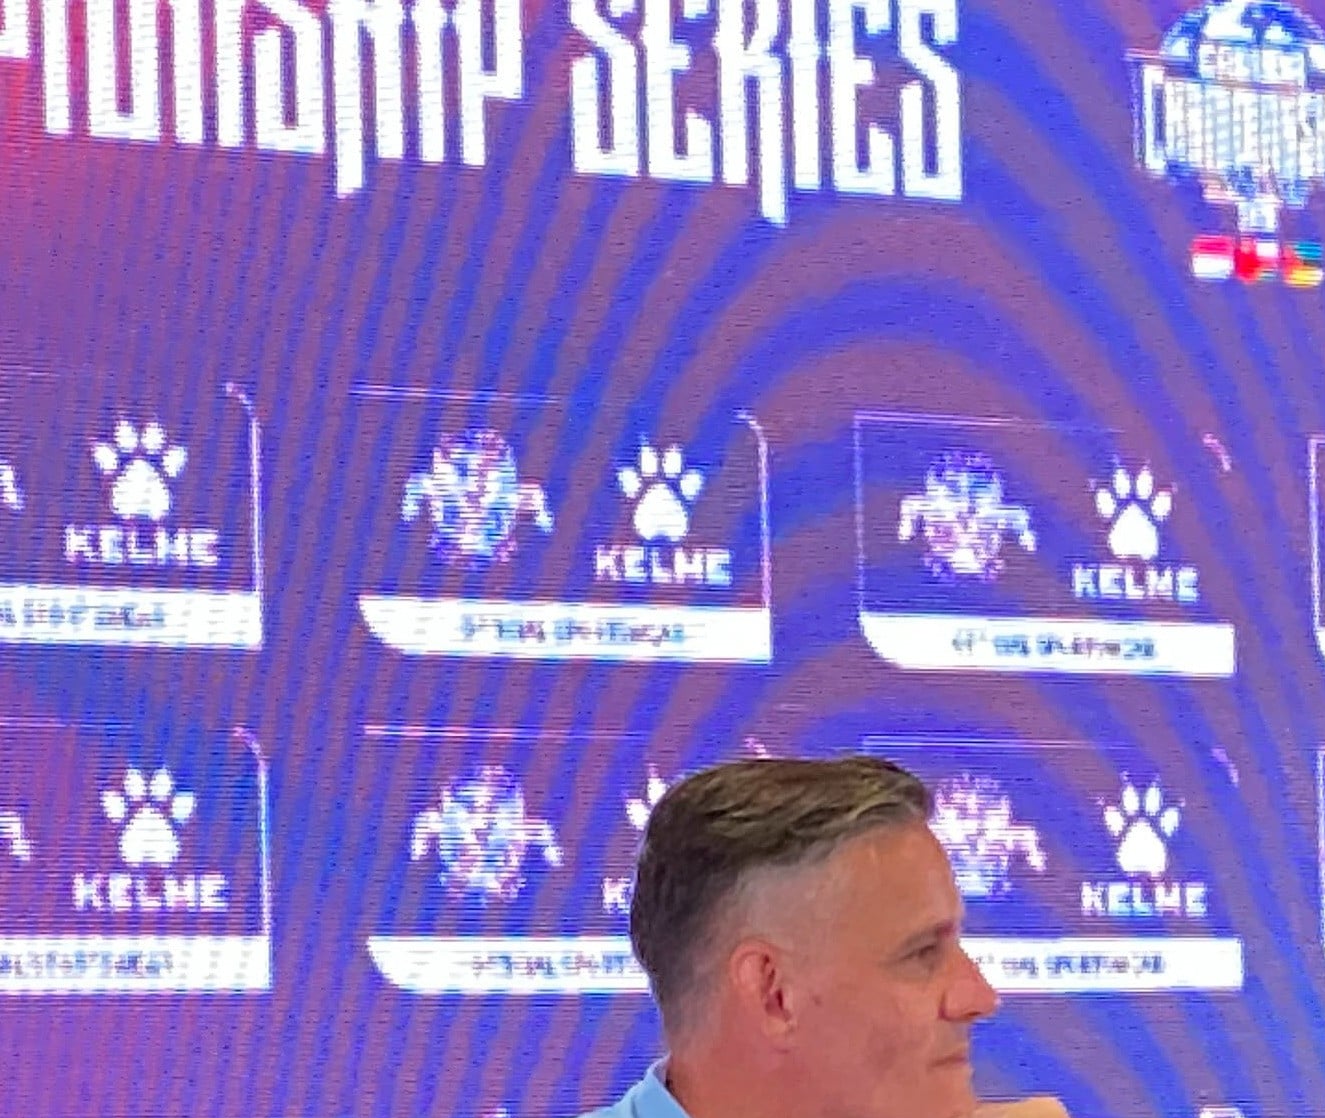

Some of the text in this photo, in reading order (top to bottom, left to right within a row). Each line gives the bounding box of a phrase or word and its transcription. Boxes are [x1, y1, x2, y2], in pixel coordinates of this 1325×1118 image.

[570, 0, 963, 226] SERIES
[64, 524, 218, 565] KELME
[594, 545, 733, 585] KELME
[1071, 565, 1199, 602] KELME
[73, 873, 229, 912] KELME
[1080, 882, 1207, 918] KELME
